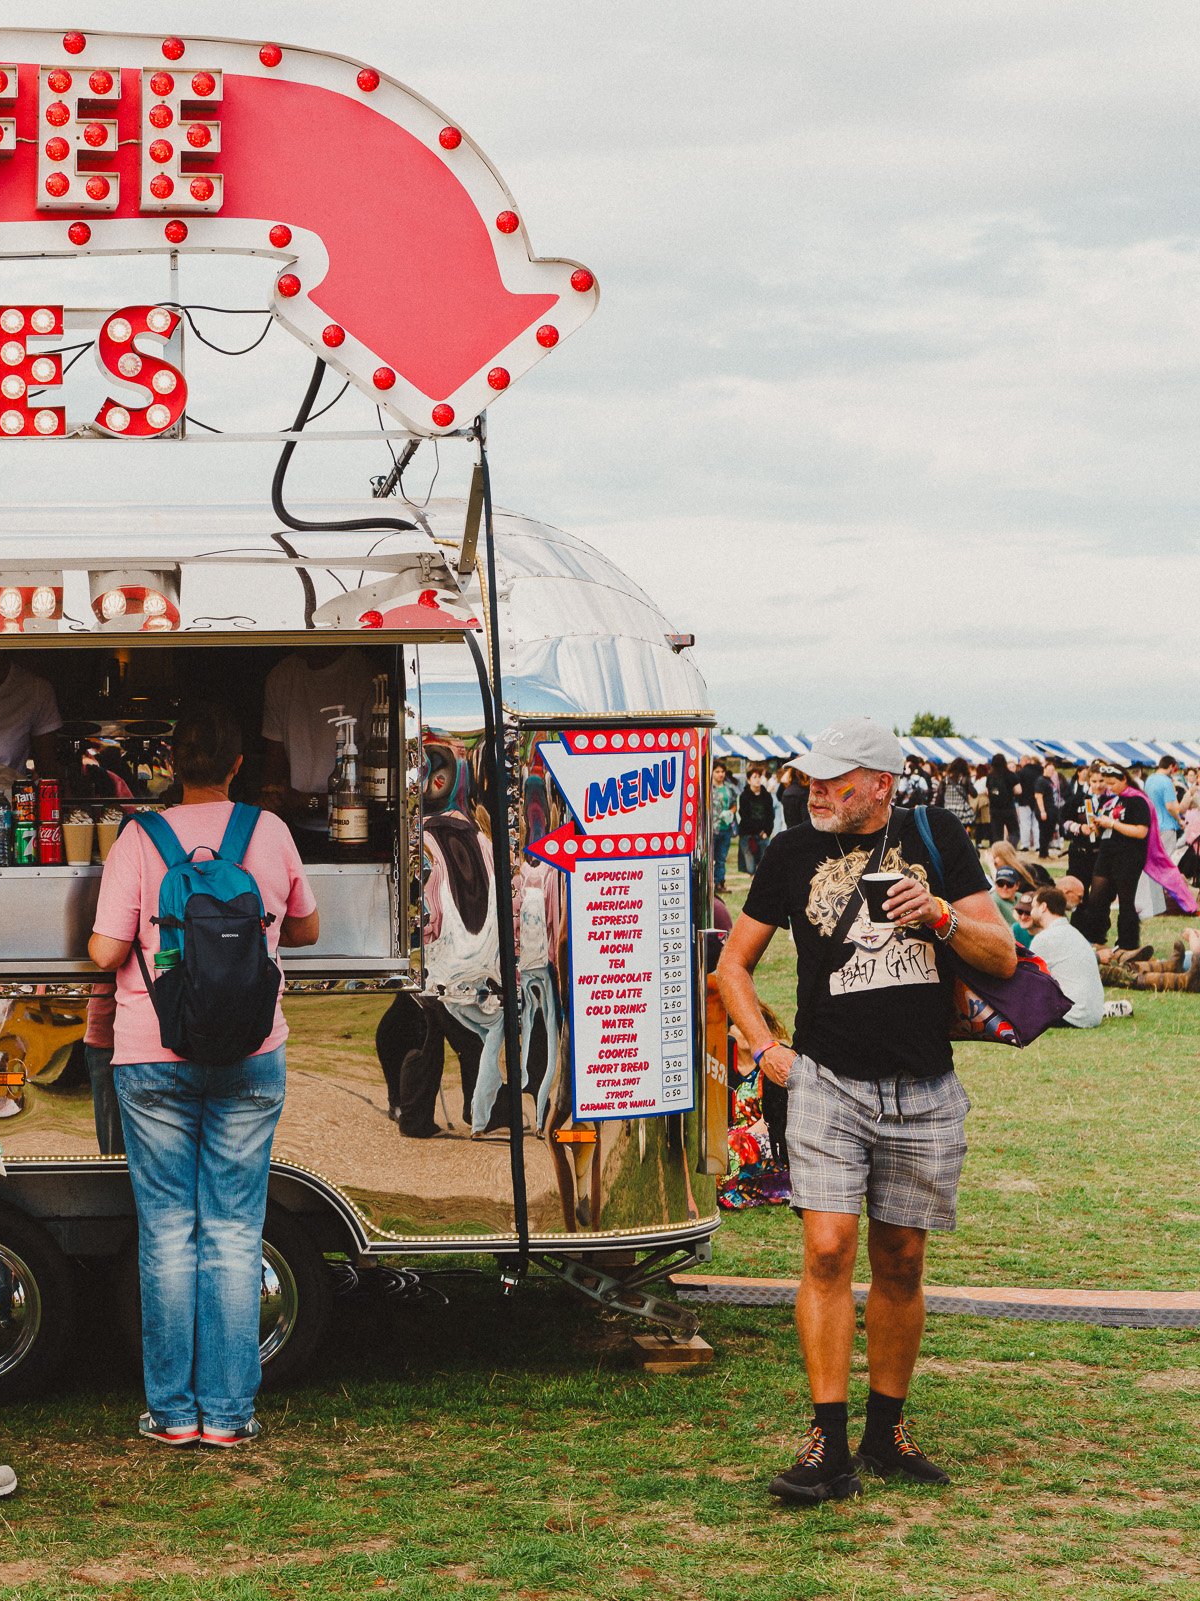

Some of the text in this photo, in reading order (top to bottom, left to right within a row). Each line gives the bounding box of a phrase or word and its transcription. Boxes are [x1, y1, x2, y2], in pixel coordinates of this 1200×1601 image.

[584, 756, 676, 823] MENU
[584, 870, 643, 882] CAPPUCCINO
[600, 885, 630, 896] LATTE
[586, 899, 643, 911] AMERICANO
[591, 914, 639, 926] ESPRESSO
[587, 928, 643, 942] FLAT WHITE
[599, 943, 633, 954] MOCHA
[608, 959, 625, 969] TEA
[577, 972, 652, 985] HOT CHOCOLATE
[840, 955, 877, 993] BAD
[590, 988, 642, 1000] ICED LATTE
[585, 1003, 647, 1016] COLD DRINKS
[601, 1018, 634, 1029] WATER
[601, 1033, 637, 1044] MUFFIN
[598, 1047, 639, 1059] COOKIES
[586, 1061, 649, 1074] SHORT BREAD
[596, 1077, 641, 1088] EXTRA SHOT
[605, 1090, 634, 1099] SYRUPS
[580, 1099, 656, 1112] CARAMEL OR VANILLA
